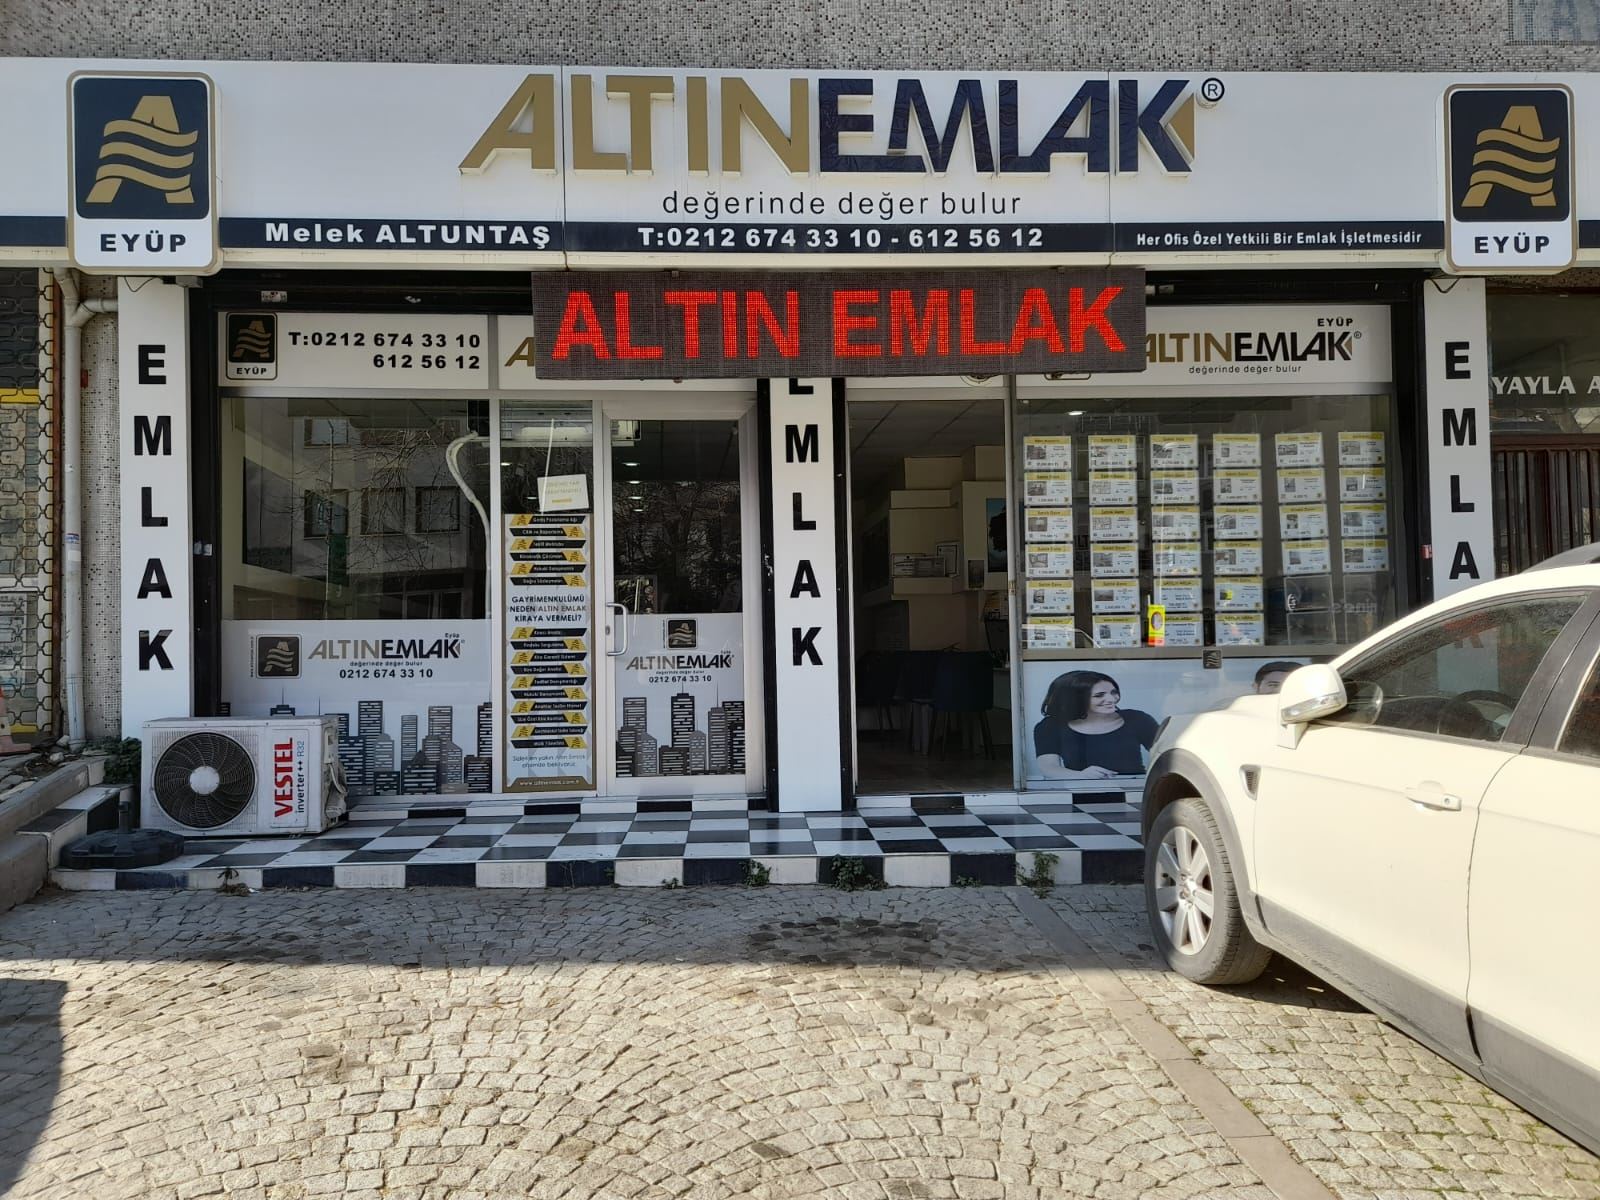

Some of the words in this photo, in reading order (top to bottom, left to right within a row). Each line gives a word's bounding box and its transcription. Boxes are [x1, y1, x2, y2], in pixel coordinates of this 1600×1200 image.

[663, 191, 825, 219] değerinde
[838, 191, 929, 219] değer
[942, 191, 1022, 215] bulur
[100, 231, 187, 253] EYÜP
[265, 223, 364, 244] Melek
[376, 225, 550, 249] ALTUNTAŞ
[639, 227, 735, 248] T:0212
[746, 227, 796, 248] 674
[807, 227, 839, 248] 33
[850, 227, 882, 248] 10
[909, 227, 959, 248] 612
[969, 227, 1001, 248] 56
[1012, 227, 1044, 247] 12
[1137, 233, 1160, 245] Her
[1164, 233, 1189, 245] Ofis
[1193, 230, 1222, 245] Özel
[1226, 232, 1269, 245] Yetkili
[1273, 232, 1293, 244] Bir
[1297, 232, 1337, 244] Emlak
[1341, 229, 1422, 246] İşletmesidir
[1474, 232, 1550, 254] EYÜP
[552, 290, 798, 361] ALTIN
[833, 287, 1127, 358] EMLAK
[1317, 317, 1354, 327] EYÜP
[288, 332, 366, 346] T:0212
[373, 333, 413, 347] 674
[421, 334, 447, 347] 33
[455, 334, 481, 348] 10
[373, 354, 413, 368] 612
[421, 355, 447, 368] 56
[455, 356, 481, 369] 12
[1189, 365, 1240, 375] değerinde
[1243, 365, 1273, 375] değer
[1276, 364, 1302, 373] bulur
[236, 366, 268, 375] EYÜP
[1491, 376, 1576, 395] YAYLA
[134, 345, 174, 671] EMLAK
[510, 605, 536, 613] NEDEN
[515, 614, 543, 622] KİRAYA
[308, 639, 461, 659] ALTINEMLAK
[626, 654, 733, 671] ALTINEMLAK
[339, 669, 370, 679] 0212
[373, 669, 396, 678] 674
[400, 669, 416, 678] 33
[419, 668, 433, 678] 10
[296, 740, 305, 757] R32
[274, 737, 294, 818] VESTEL
